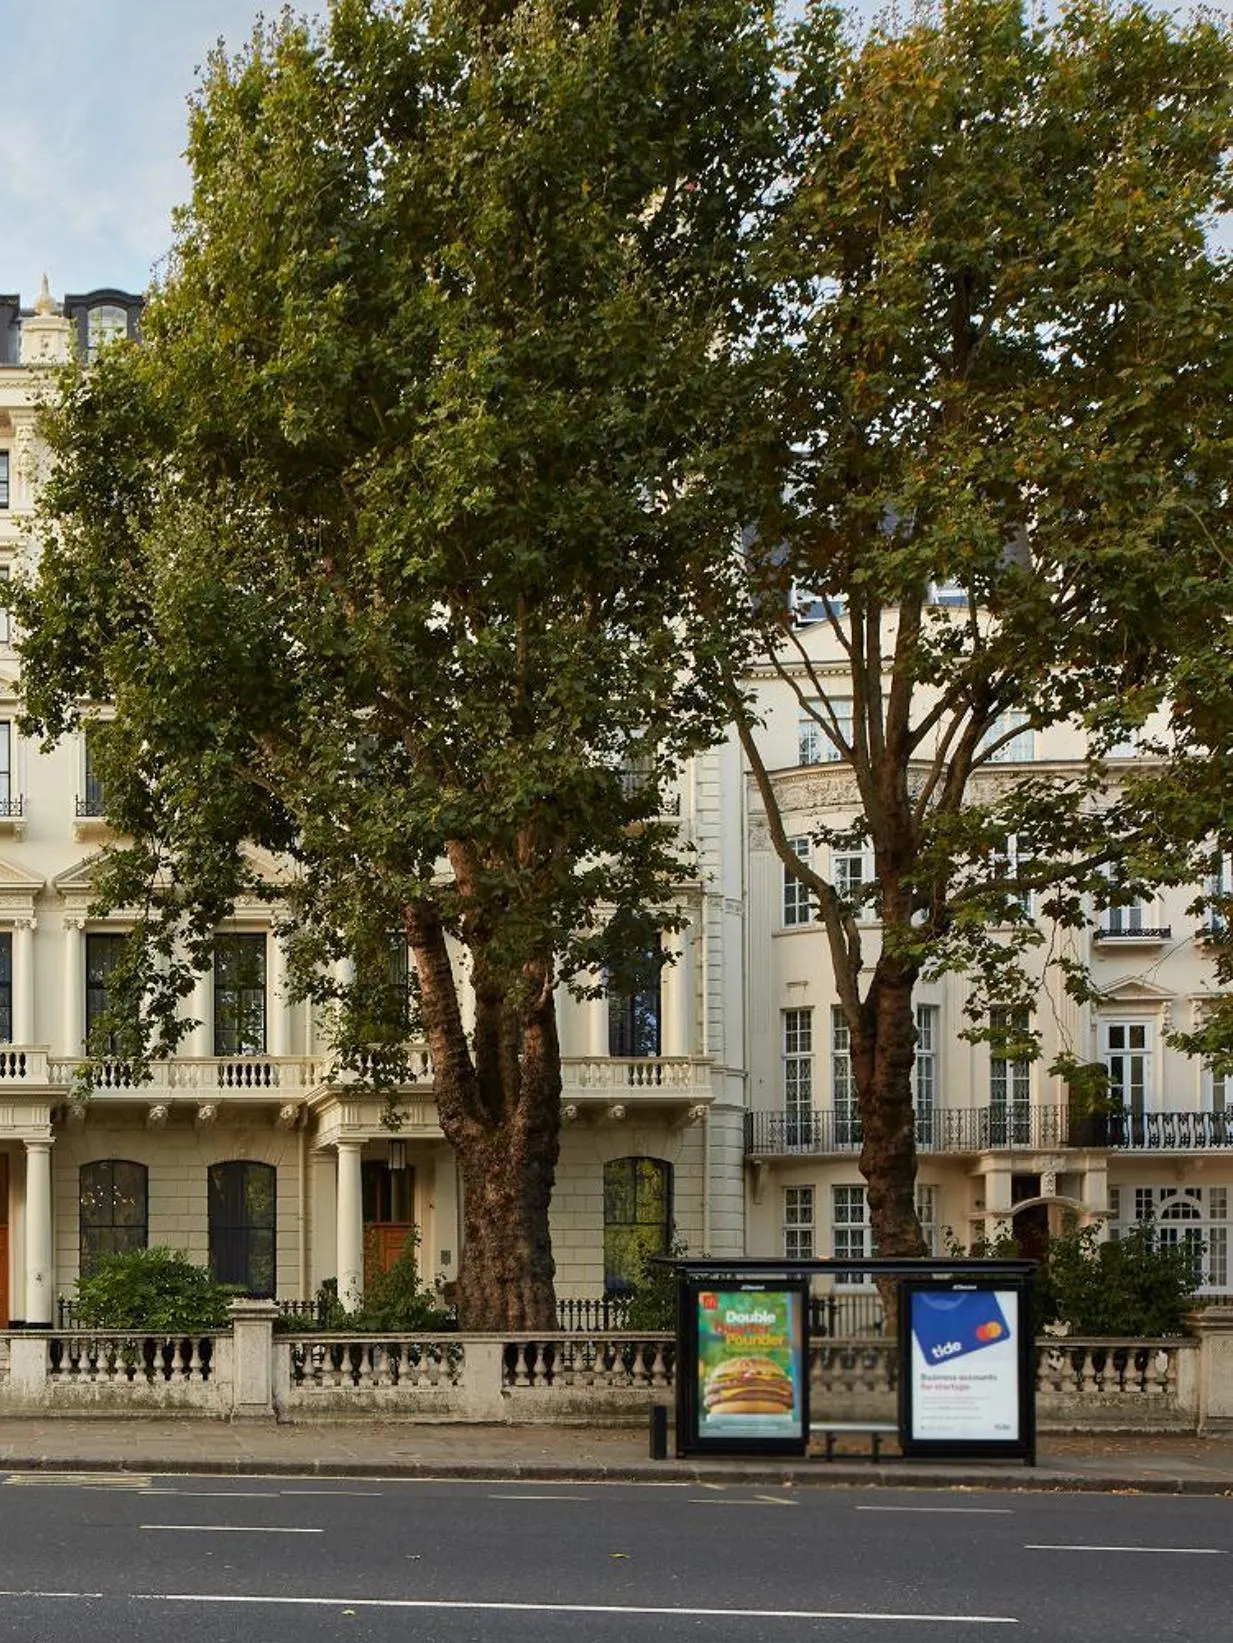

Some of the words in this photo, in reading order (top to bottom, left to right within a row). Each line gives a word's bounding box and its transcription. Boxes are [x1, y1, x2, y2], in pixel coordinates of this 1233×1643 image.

[726, 1310, 776, 1324] Double
[725, 1333, 785, 1346] Pounder
[931, 1340, 962, 1358] tide
